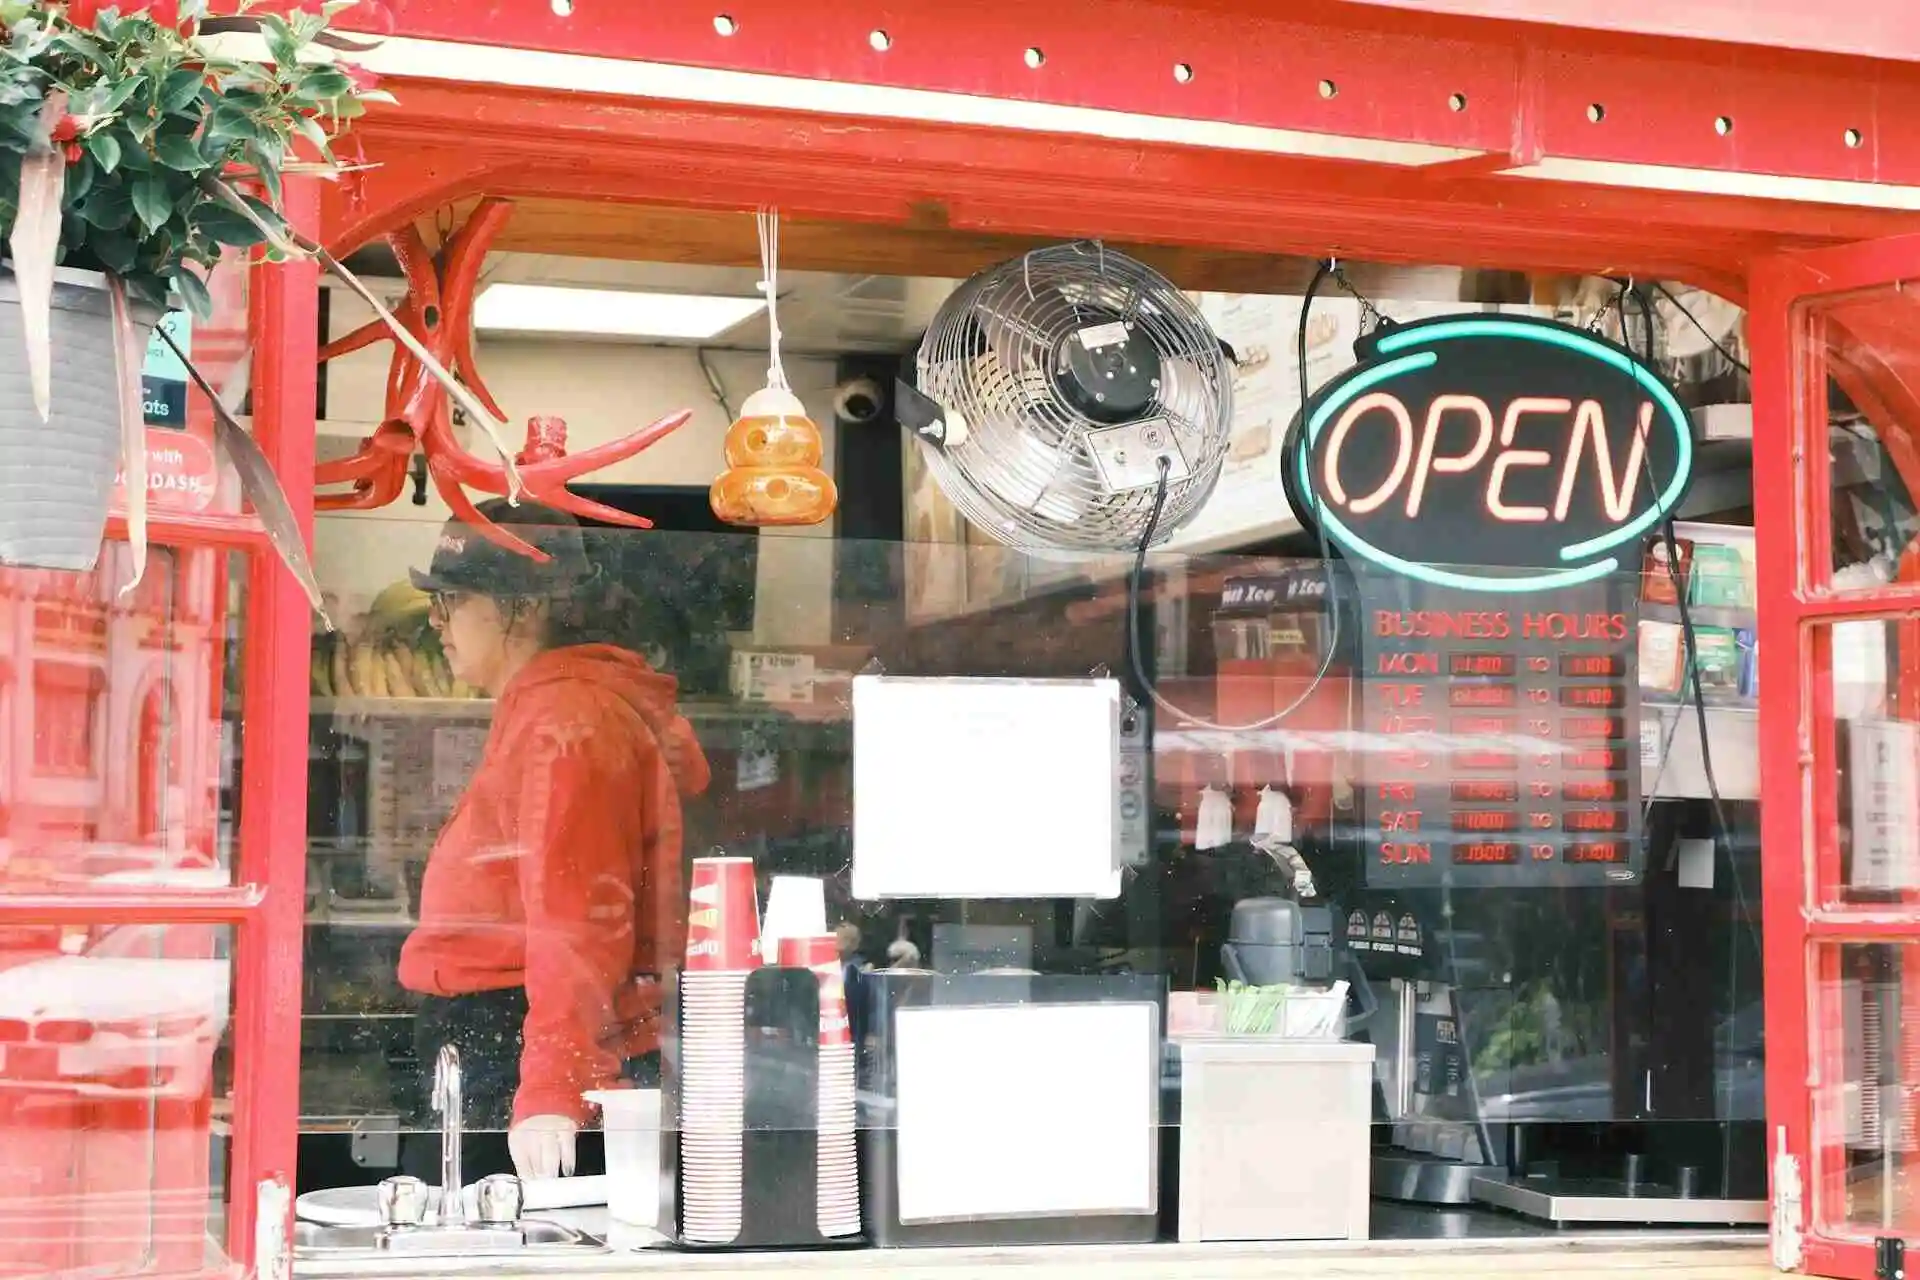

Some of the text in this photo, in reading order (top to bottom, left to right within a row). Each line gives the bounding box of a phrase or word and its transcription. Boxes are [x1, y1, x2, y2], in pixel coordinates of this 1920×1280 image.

[142, 402, 170, 416] ats
[152, 449, 184, 465] with
[1324, 392, 1653, 522] OPEN
[1374, 610, 1629, 641] BUSINESS HOURS
[1377, 652, 1440, 675] MON
[1527, 656, 1551, 672] TO
[1376, 684, 1426, 707] TUE
[1527, 688, 1551, 705] TO
[1529, 719, 1553, 736] TO
[1529, 780, 1554, 797] TO
[1380, 810, 1423, 832] SAT
[1529, 812, 1553, 829] TO
[1380, 842, 1432, 865] SUN
[1529, 844, 1554, 861] TO
